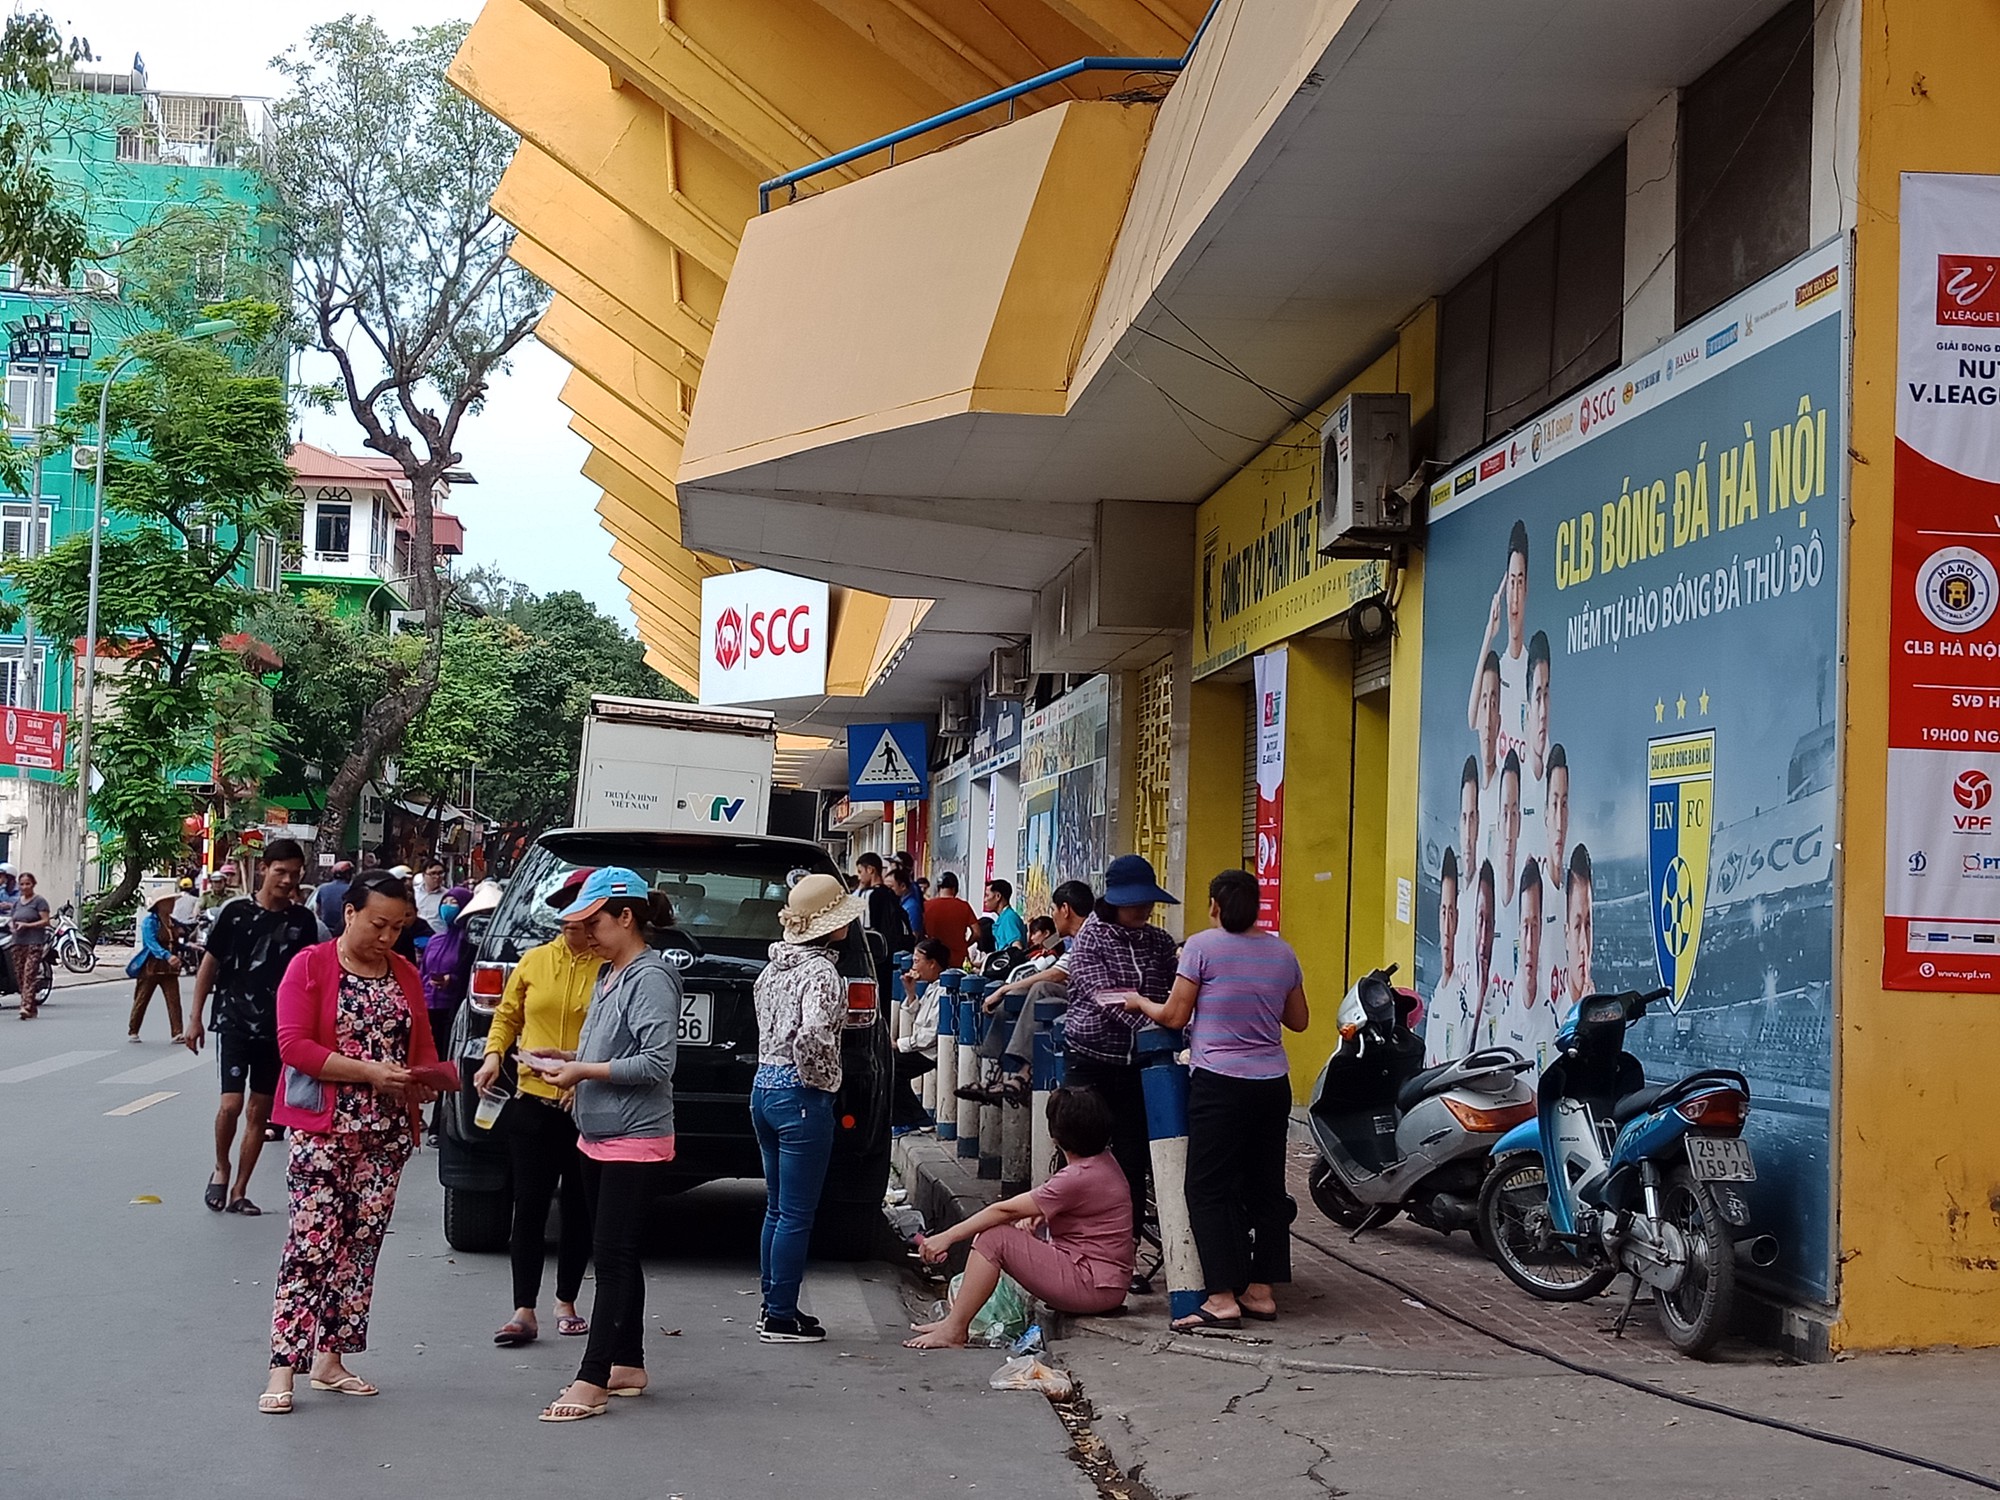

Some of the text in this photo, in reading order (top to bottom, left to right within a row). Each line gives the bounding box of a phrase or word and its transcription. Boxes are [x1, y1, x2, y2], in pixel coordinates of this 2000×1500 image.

[1909, 383, 2000, 405] V.LEAG
[1592, 387, 1616, 425] SCG
[1555, 394, 1827, 591] CLB BÓNG ĐÁ HÀ NỘI
[1938, 564, 1978, 580] HANOI
[1566, 528, 1825, 655] NIỀM TỰ HÀO BÓNG ĐÁ THỦ ĐÔ
[1263, 603, 1283, 629] JOINT
[1285, 592, 1308, 619] STOCK
[749, 605, 810, 659] SCG
[1904, 640, 1934, 655] CLB
[1952, 694, 1984, 708] SVĐ
[1922, 728, 2000, 743] 19H00 NG
[1653, 802, 1674, 830] HN
[1686, 799, 1705, 828] FC
[1953, 815, 1992, 830] VPF
[1746, 824, 1824, 880] SCG
[1937, 970, 1991, 980] www.vpf.vn
[683, 995, 697, 1017] Z
[676, 1018, 702, 1040] 86
